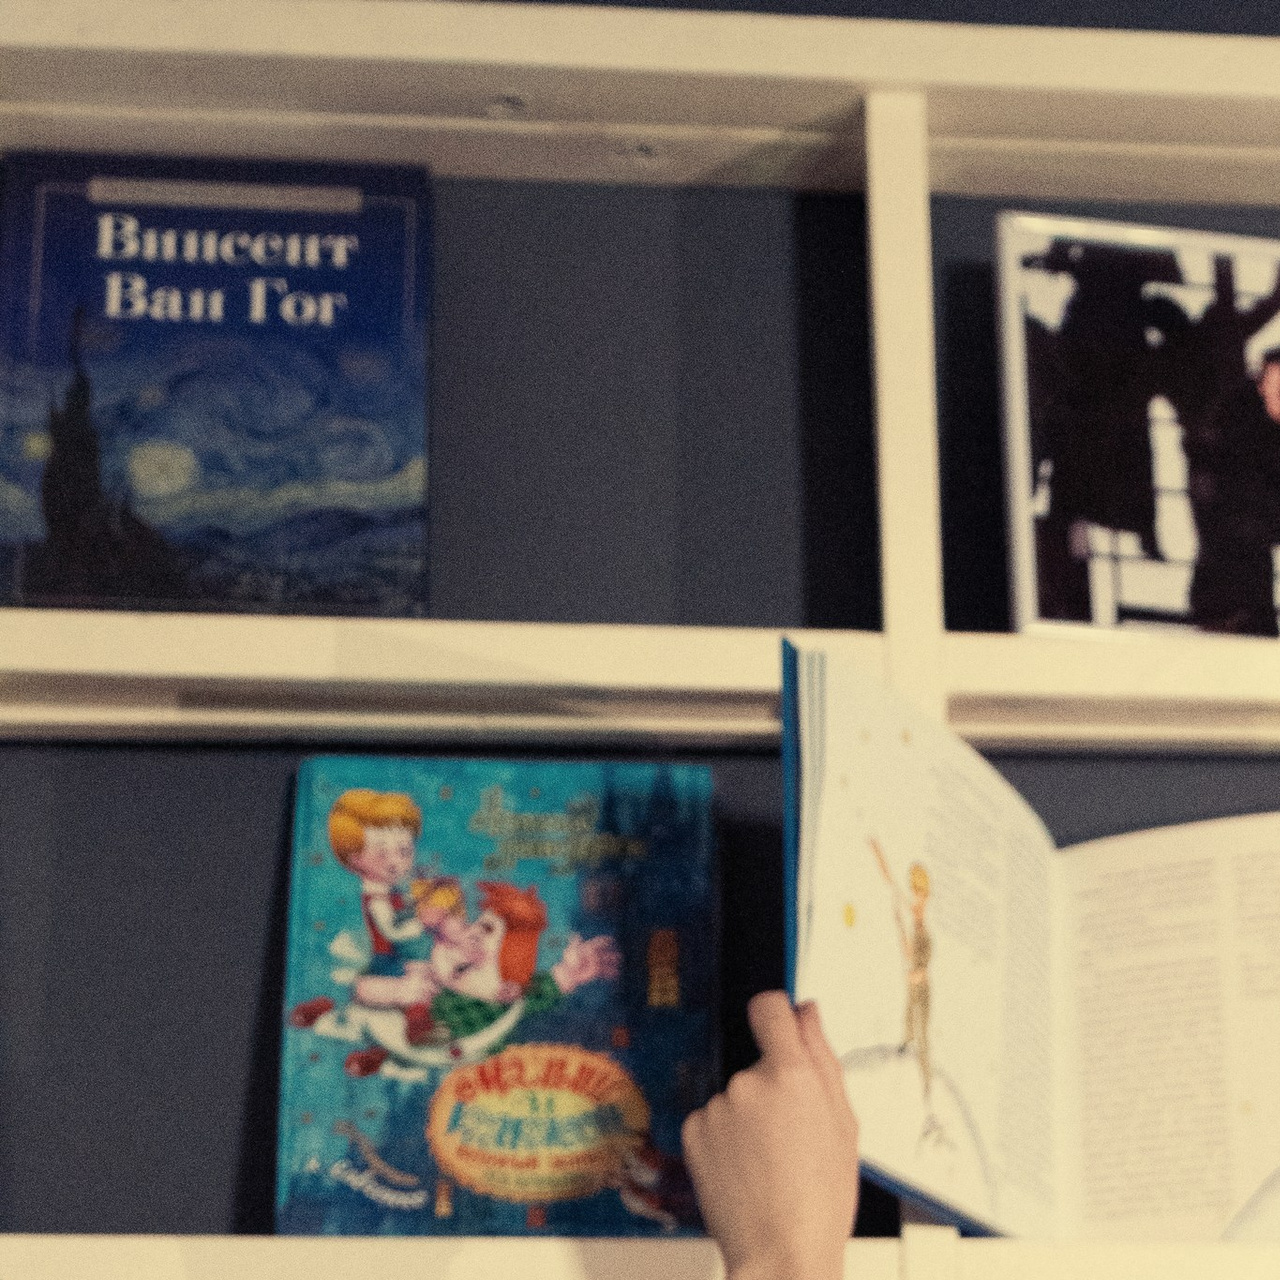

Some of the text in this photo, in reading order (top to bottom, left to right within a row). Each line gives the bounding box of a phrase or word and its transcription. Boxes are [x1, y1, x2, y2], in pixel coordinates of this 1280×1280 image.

[96, 211, 361, 271] Винсент
[103, 272, 348, 328] Ван Гог
